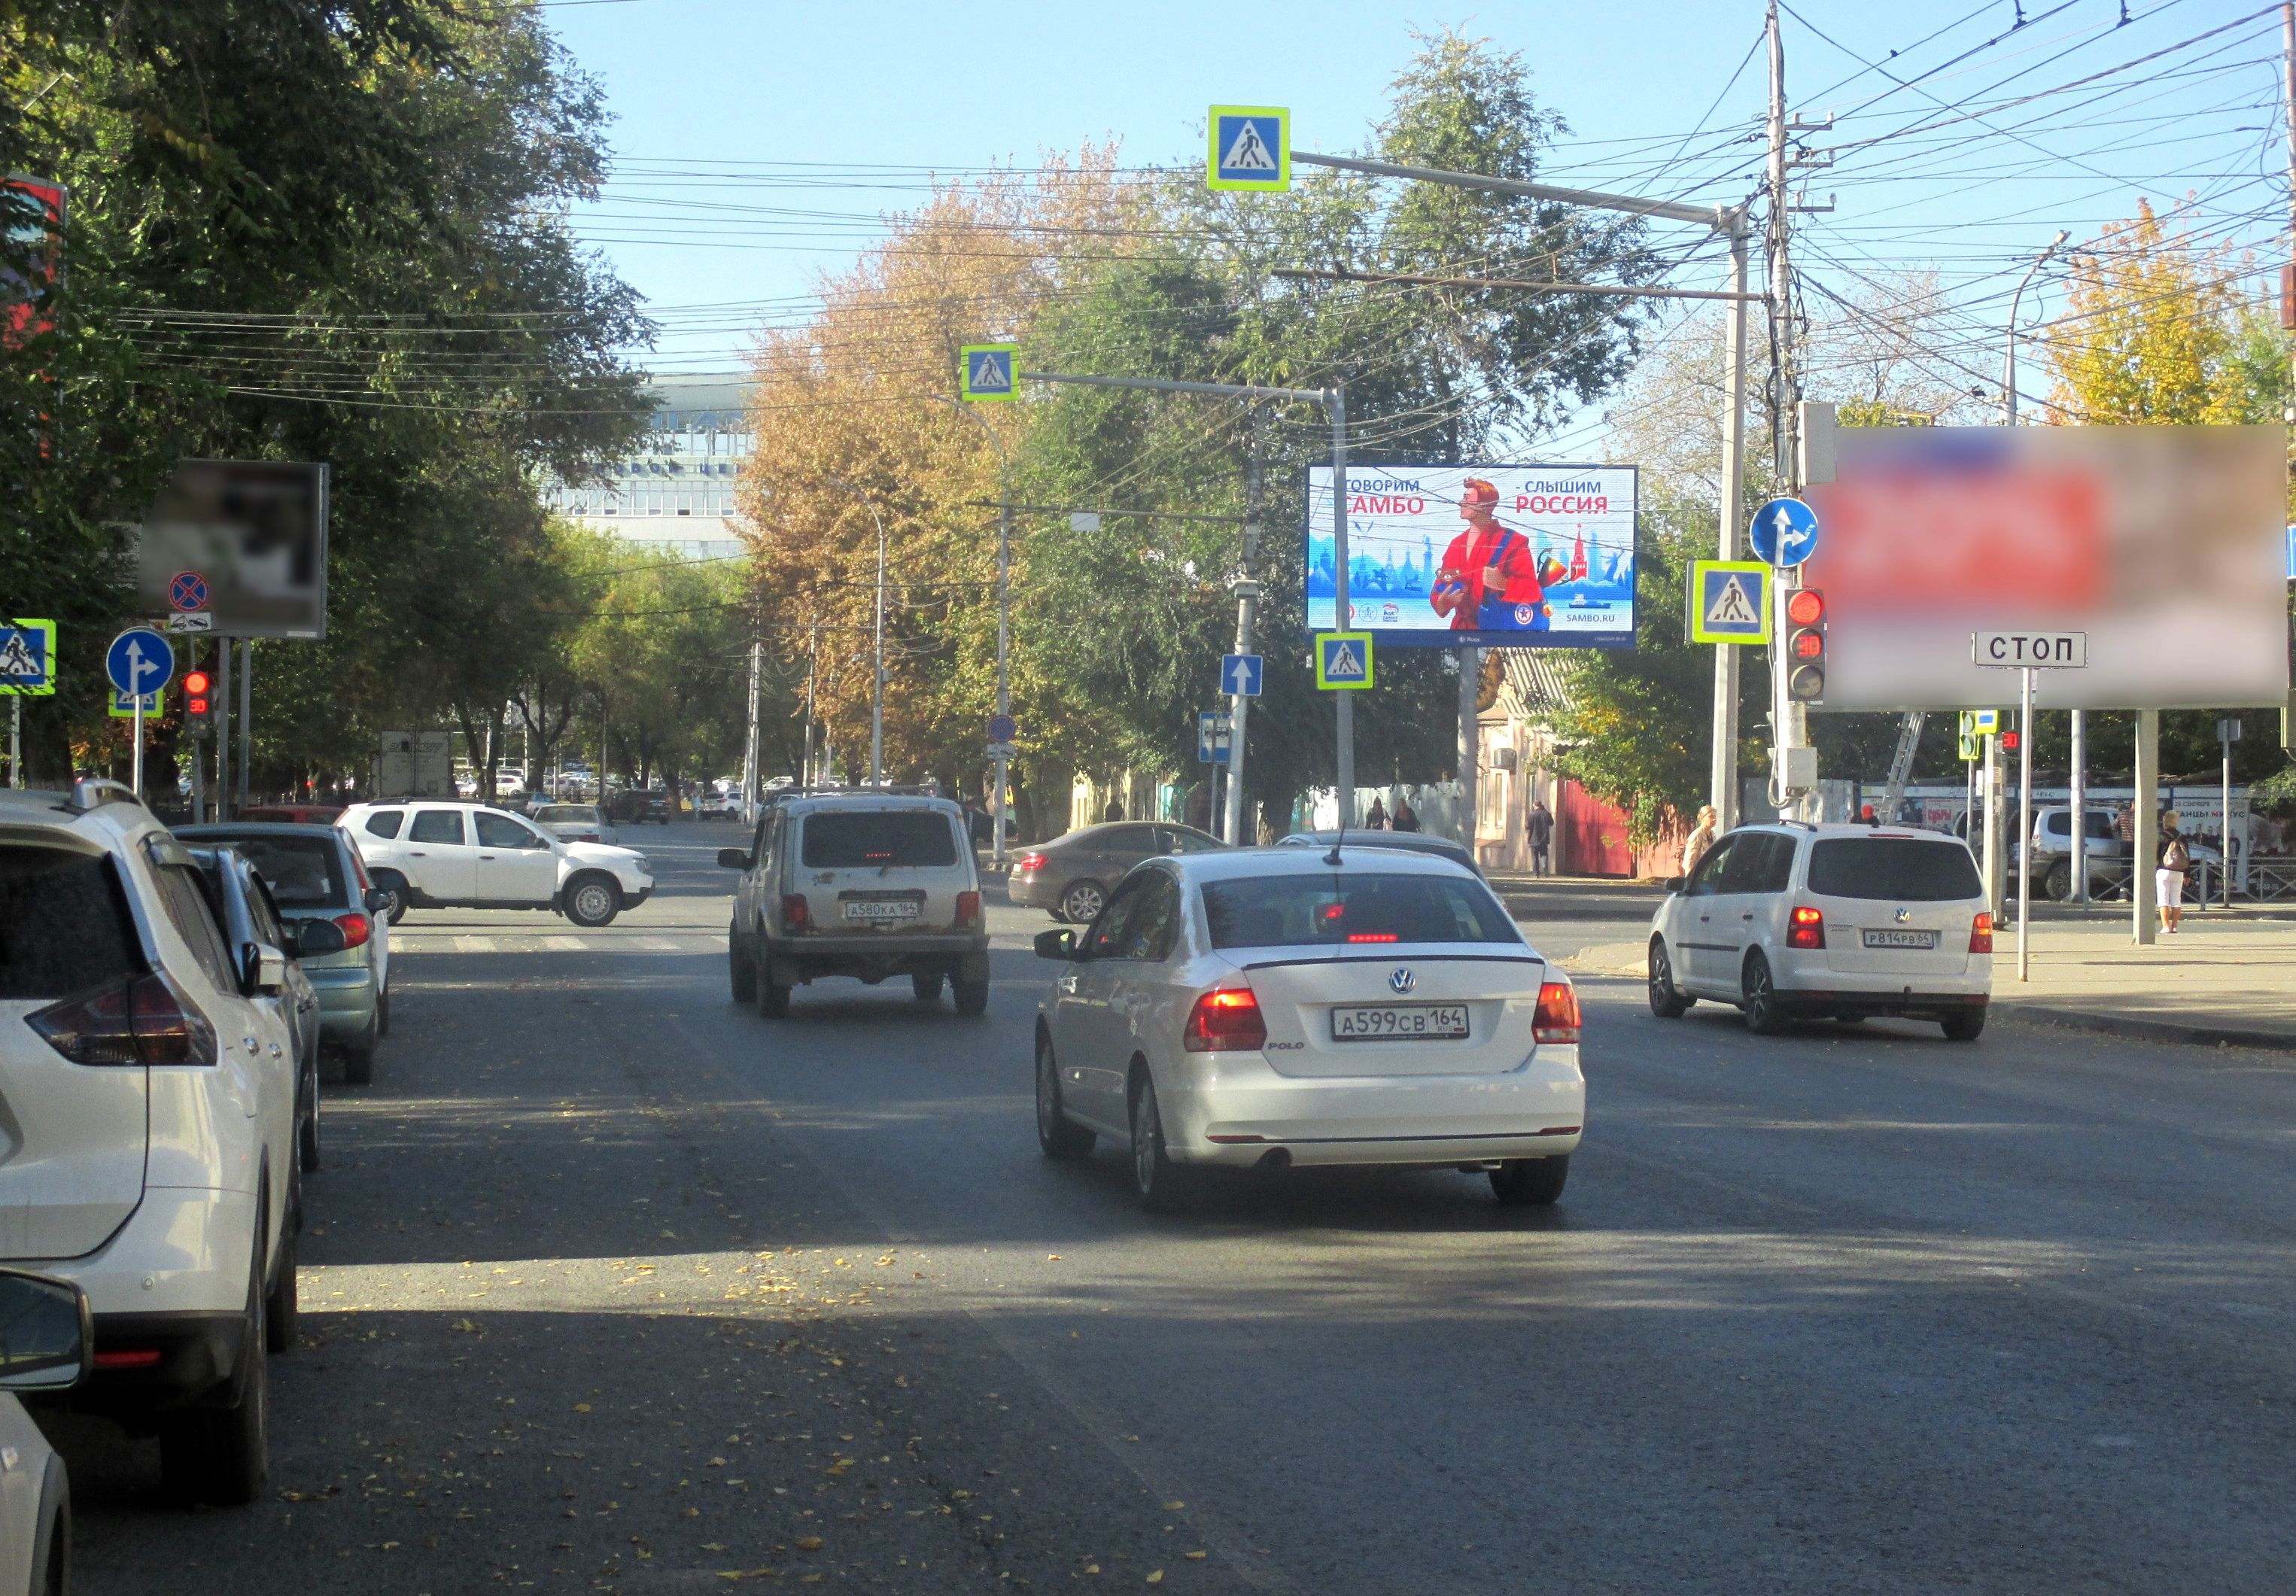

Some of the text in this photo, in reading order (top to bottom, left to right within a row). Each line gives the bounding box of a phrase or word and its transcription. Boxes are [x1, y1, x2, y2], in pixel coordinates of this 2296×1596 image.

[1525, 480, 1601, 494] СЛЫШИМ
[1516, 495, 1607, 514] РОССИЯ
[1566, 614, 1616, 623] SAMBO.RU
[1989, 637, 2072, 661] СТОП
[1342, 1009, 1463, 1034] А599СВ 164
[1267, 1041, 1305, 1050] POLO
